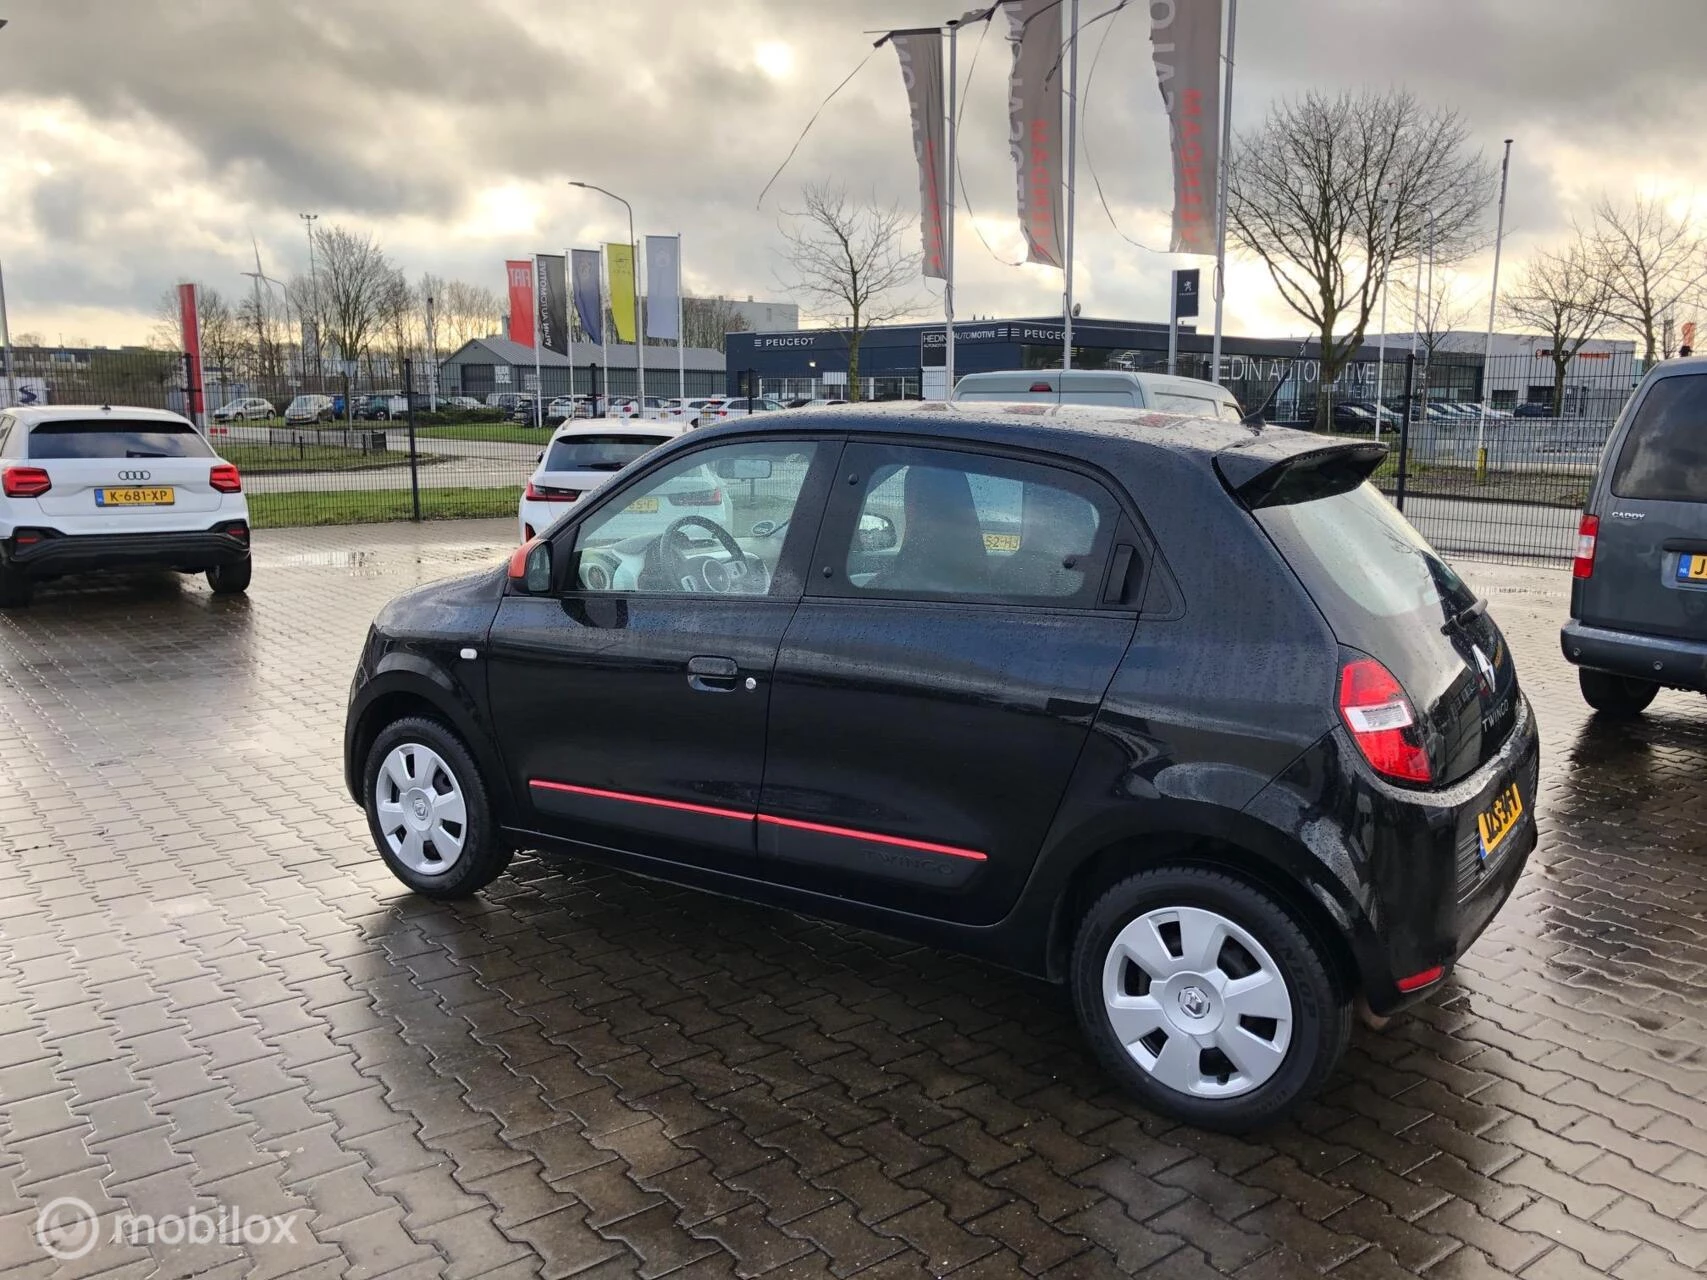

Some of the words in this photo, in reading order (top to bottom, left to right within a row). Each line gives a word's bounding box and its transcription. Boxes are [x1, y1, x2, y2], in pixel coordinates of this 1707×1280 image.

[765, 337, 815, 347] PEUGEOT
[1267, 359, 1376, 384] AUTOTIVE
[110, 490, 168, 502] K-681-XP
[1611, 511, 1646, 520] CADDY
[1482, 699, 1509, 732] TWINGO
